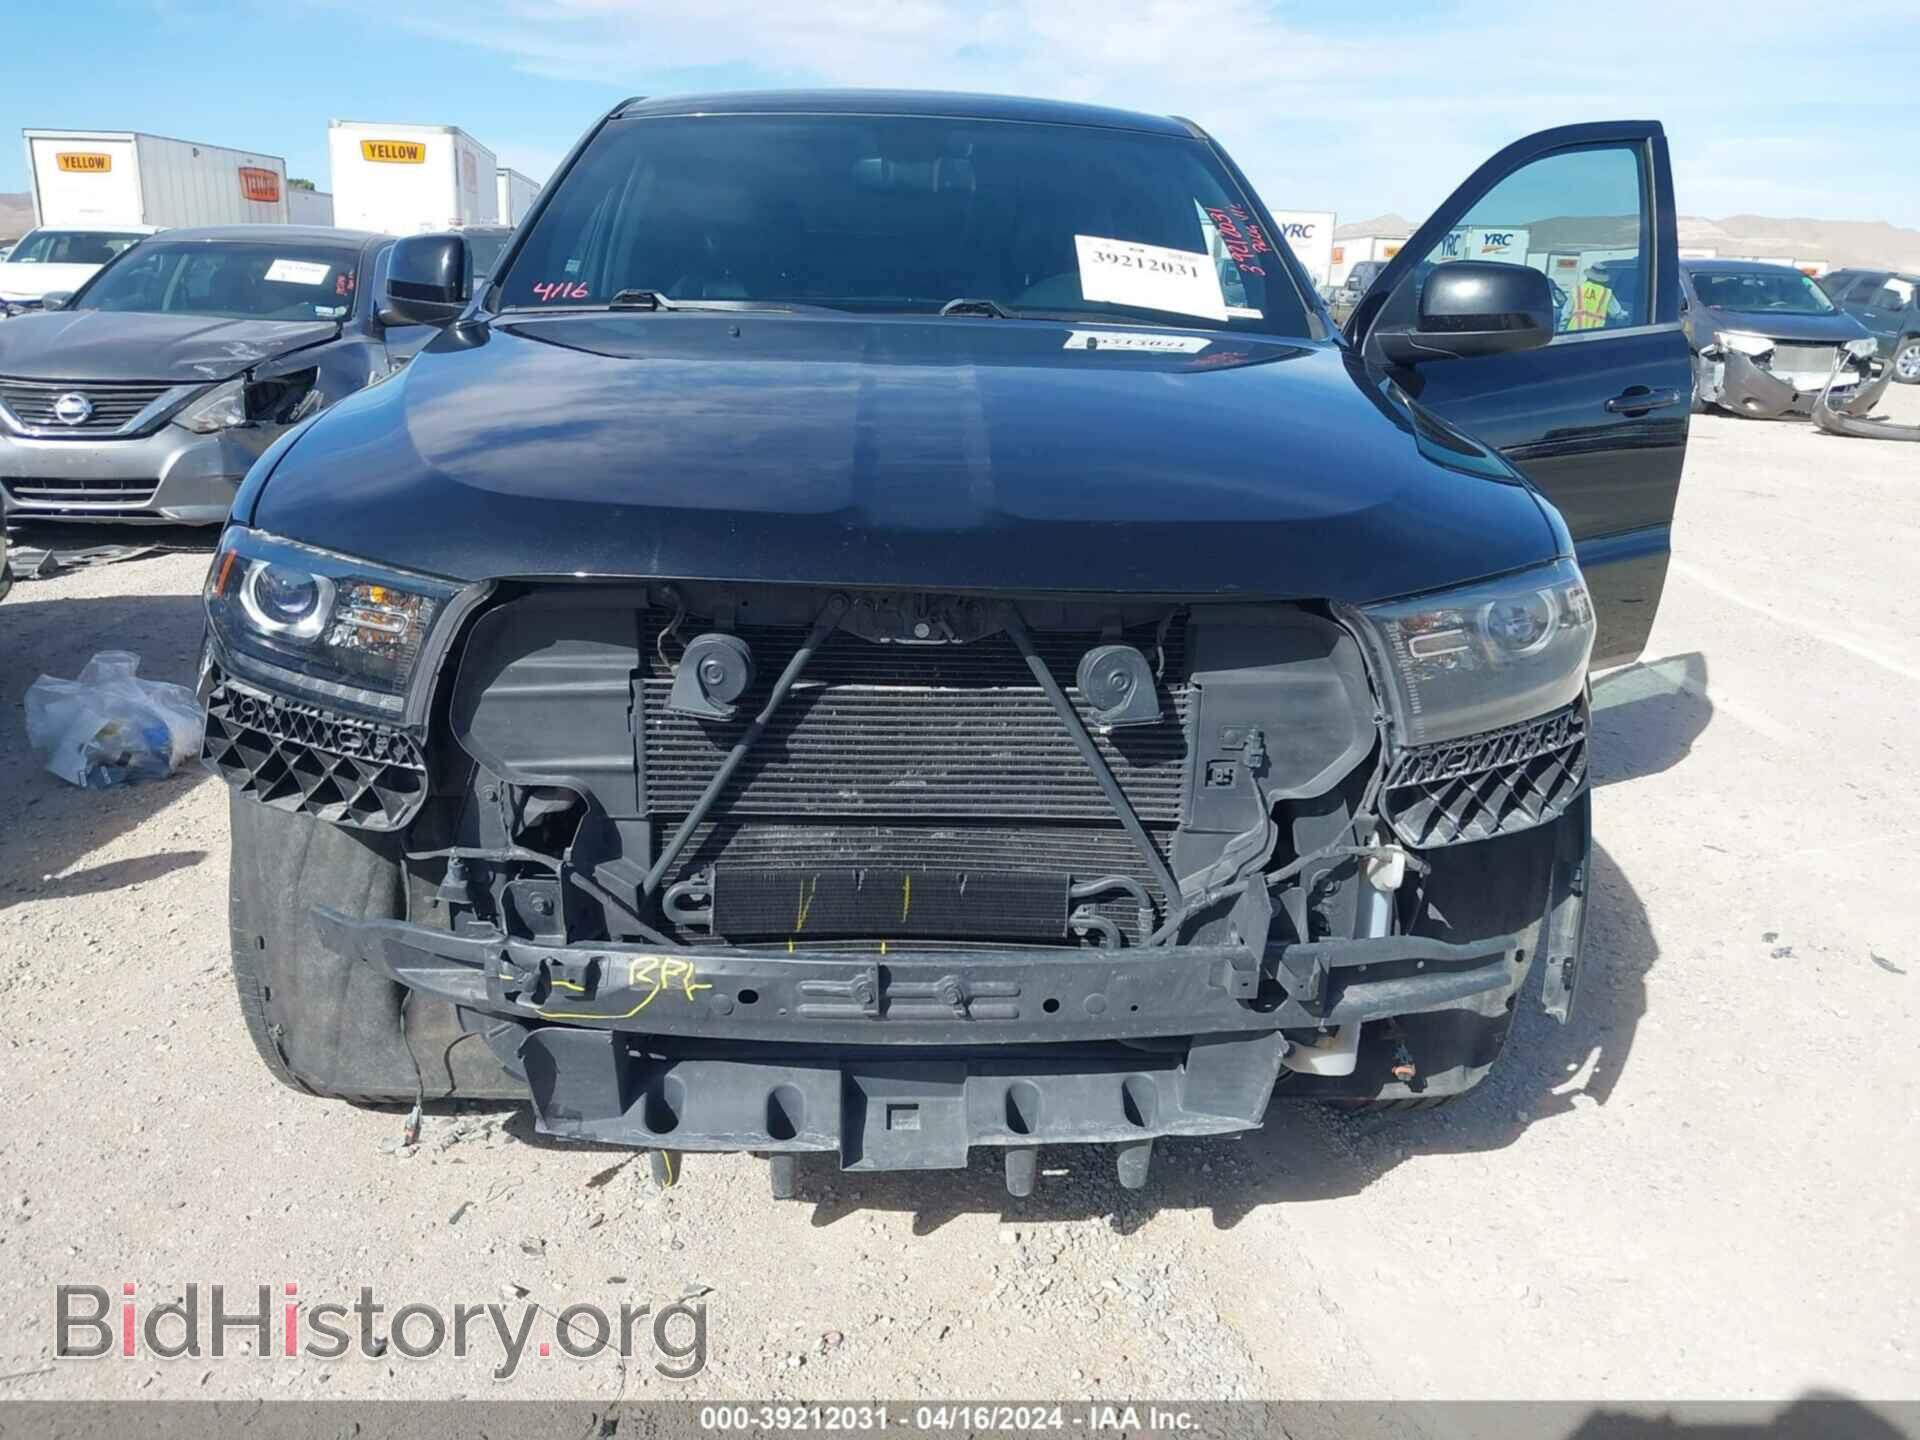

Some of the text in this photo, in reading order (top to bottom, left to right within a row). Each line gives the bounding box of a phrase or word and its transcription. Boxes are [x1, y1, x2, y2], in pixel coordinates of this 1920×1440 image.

[368, 143, 418, 160] YELLOW
[63, 155, 105, 169] YELLOW
[1281, 223, 1316, 239] YRC
[1484, 233, 1514, 247] YRC
[1092, 250, 1198, 278] 39212031
[533, 281, 588, 301] 4/16
